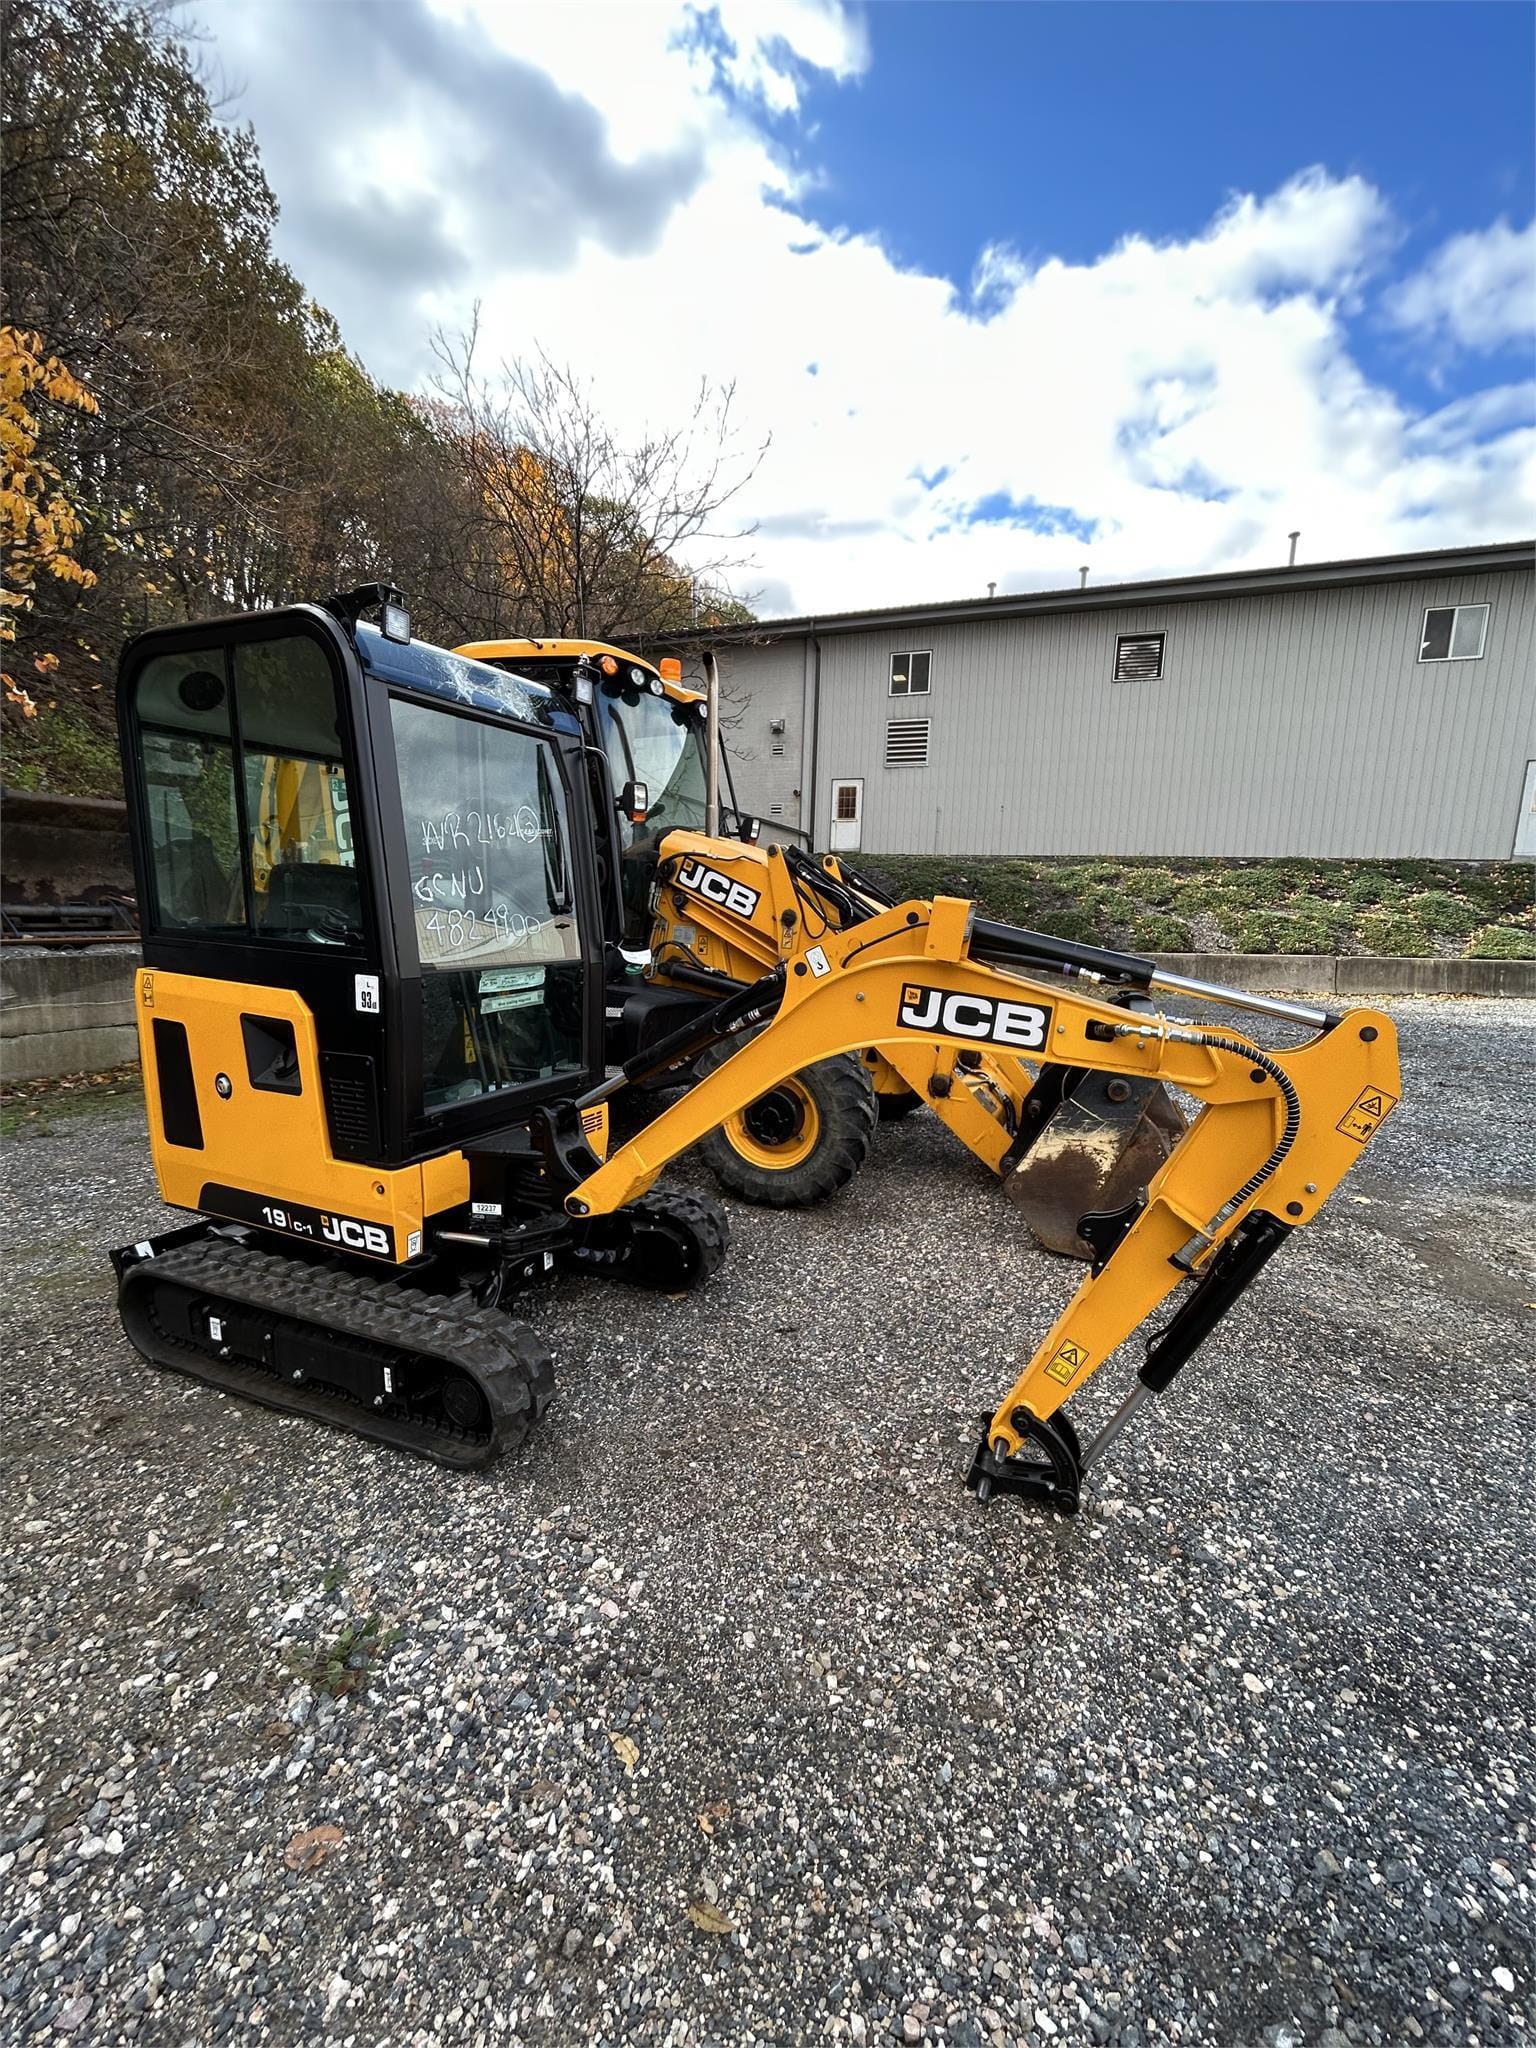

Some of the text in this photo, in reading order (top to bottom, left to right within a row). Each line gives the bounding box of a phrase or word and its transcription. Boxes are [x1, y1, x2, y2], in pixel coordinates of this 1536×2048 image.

[414, 866, 484, 902] GCNU
[679, 864, 757, 916] JCB
[426, 904, 541, 946] 4824900
[901, 991, 1046, 1047] JCB
[262, 1206, 287, 1228] 19
[322, 1217, 390, 1254] JCB
[476, 1204, 497, 1212] 12237
